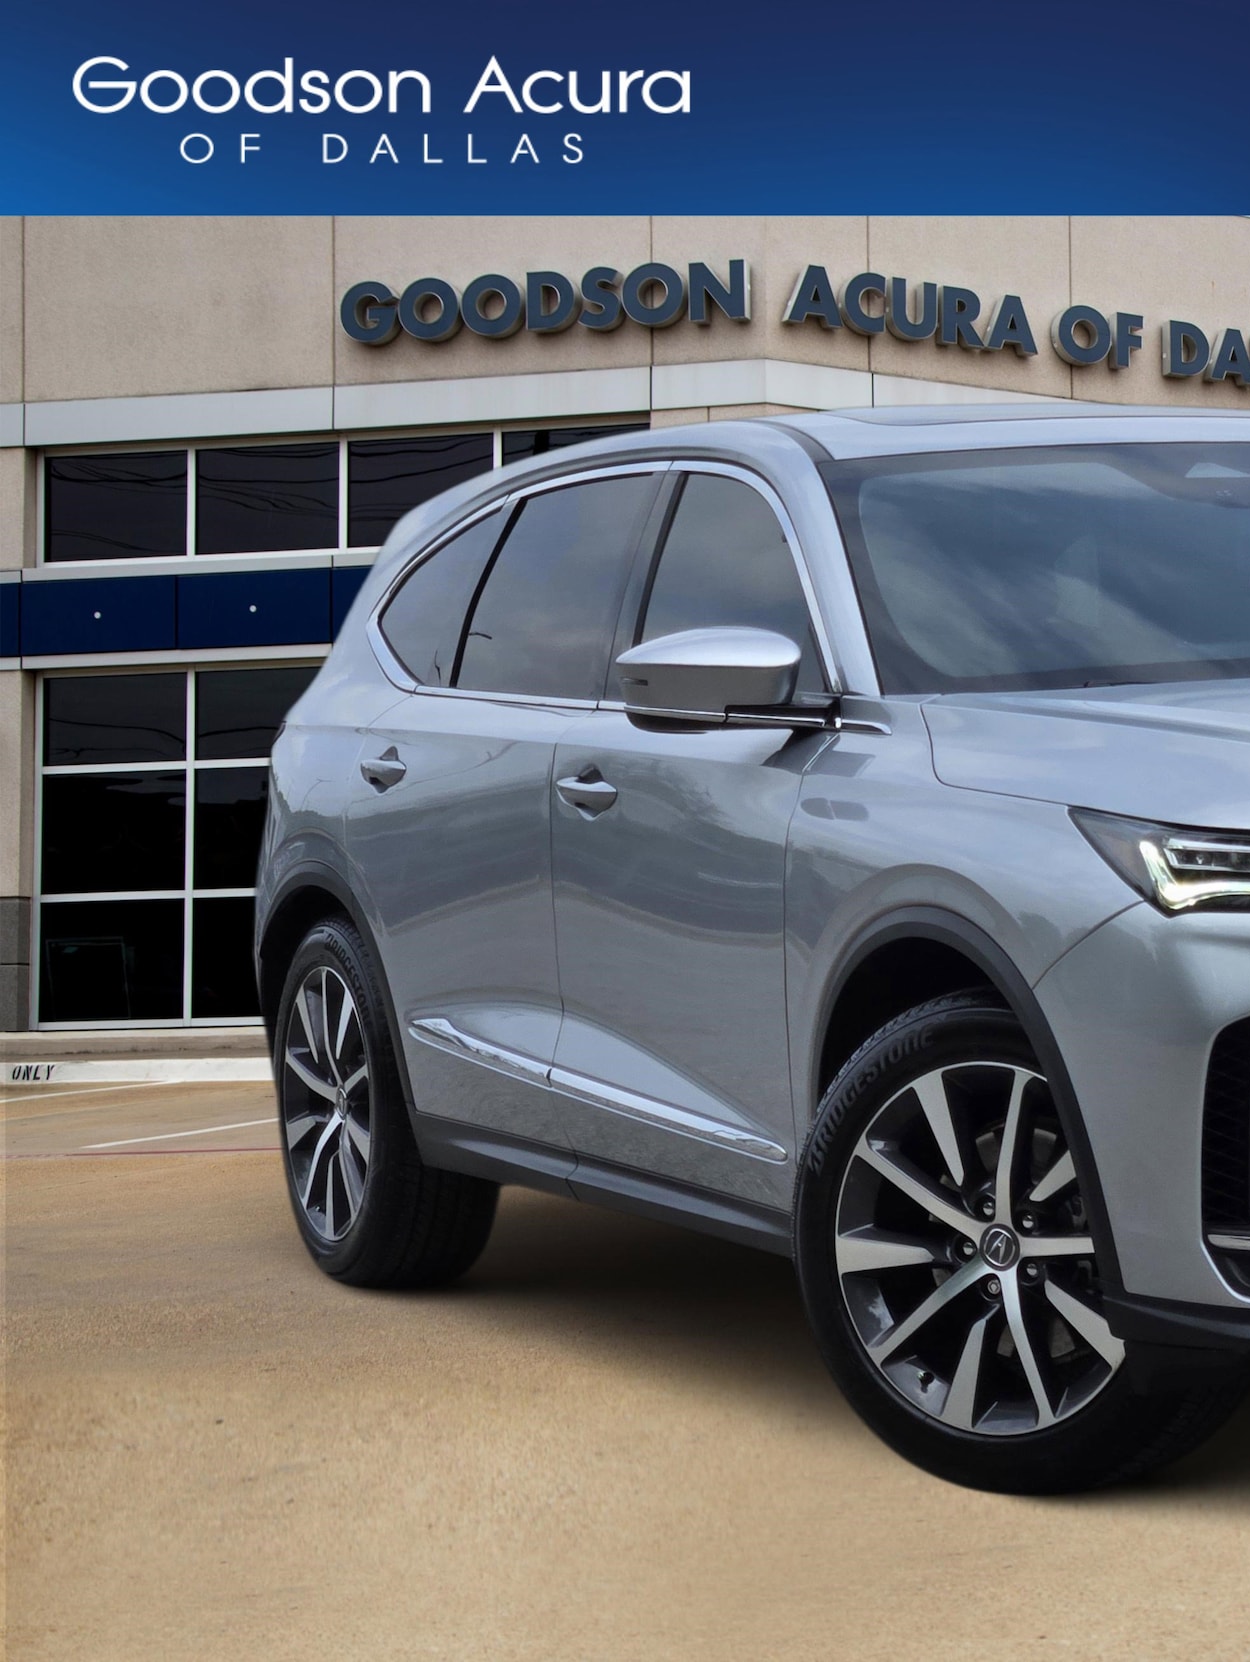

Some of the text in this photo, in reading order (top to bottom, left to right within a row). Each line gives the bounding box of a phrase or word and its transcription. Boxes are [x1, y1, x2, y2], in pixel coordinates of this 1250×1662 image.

[340, 259, 751, 347] GOODSON
[782, 264, 1038, 358] ACURA
[1052, 305, 1144, 371] OF
[12, 1064, 55, 1081] ONLY
[807, 1023, 934, 1175] BRIDGESTONE
